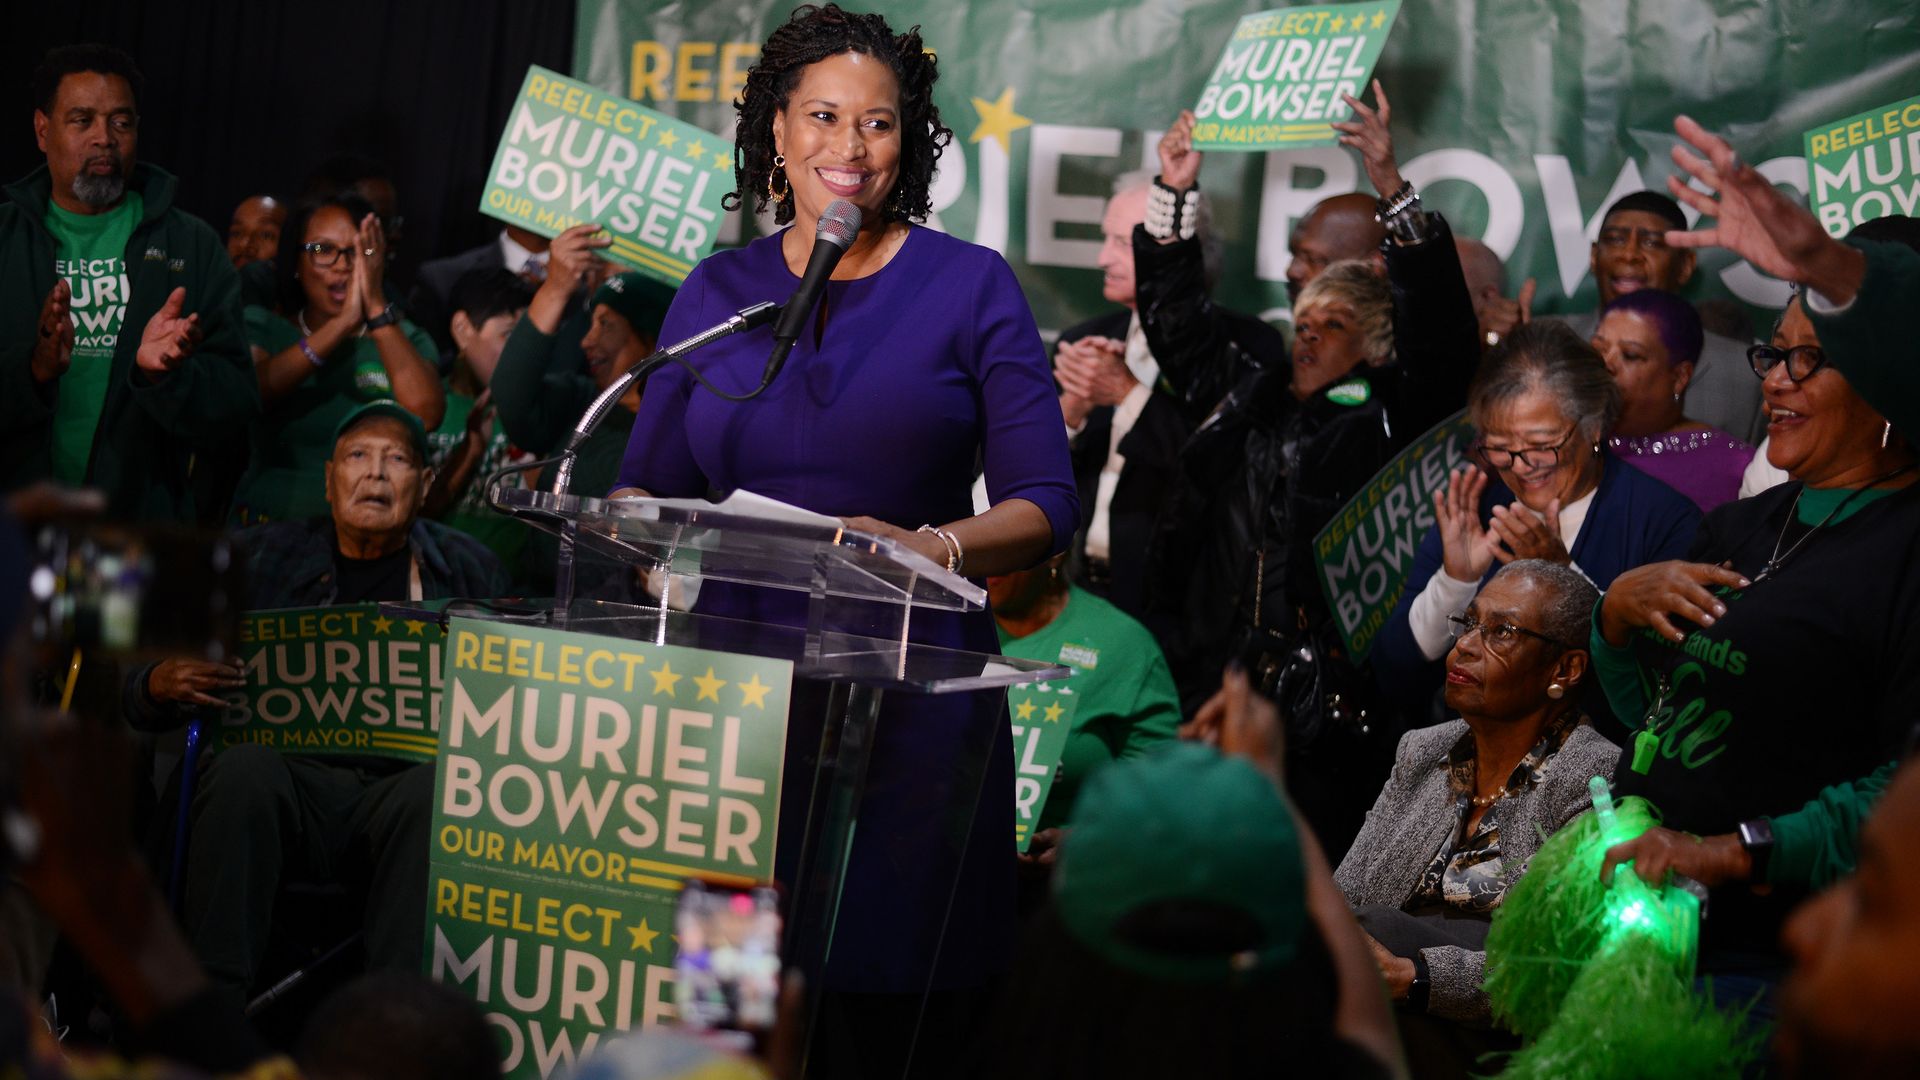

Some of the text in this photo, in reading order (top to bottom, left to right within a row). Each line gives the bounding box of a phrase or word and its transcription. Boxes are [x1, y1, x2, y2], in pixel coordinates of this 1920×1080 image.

[1237, 12, 1331, 40] REELECT
[1211, 35, 1366, 83] MURIEL
[526, 73, 658, 141] REELECT
[1194, 80, 1356, 121] BOWSER
[1221, 124, 1281, 144] MAYOR
[1811, 104, 1920, 158] REELEC
[509, 101, 717, 222] MURIEL
[488, 188, 534, 221] OUR
[495, 146, 708, 261] BOWSER
[1320, 457, 1409, 559] REELECT
[1325, 434, 1463, 598] MURIEL
[1337, 492, 1437, 634] BOWS
[239, 612, 365, 642] EELECT
[1353, 611, 1385, 654] OUR
[245, 640, 444, 688] MURIEL
[455, 630, 645, 692] REELECT
[222, 728, 369, 748] OUR MAYOR
[448, 676, 766, 795] MURIEL
[442, 754, 762, 866] BOWSER
[440, 825, 506, 861] OUR
[513, 838, 627, 883] MAYOR
[436, 878, 623, 947] REELECT
[432, 922, 680, 1033] MURIE
